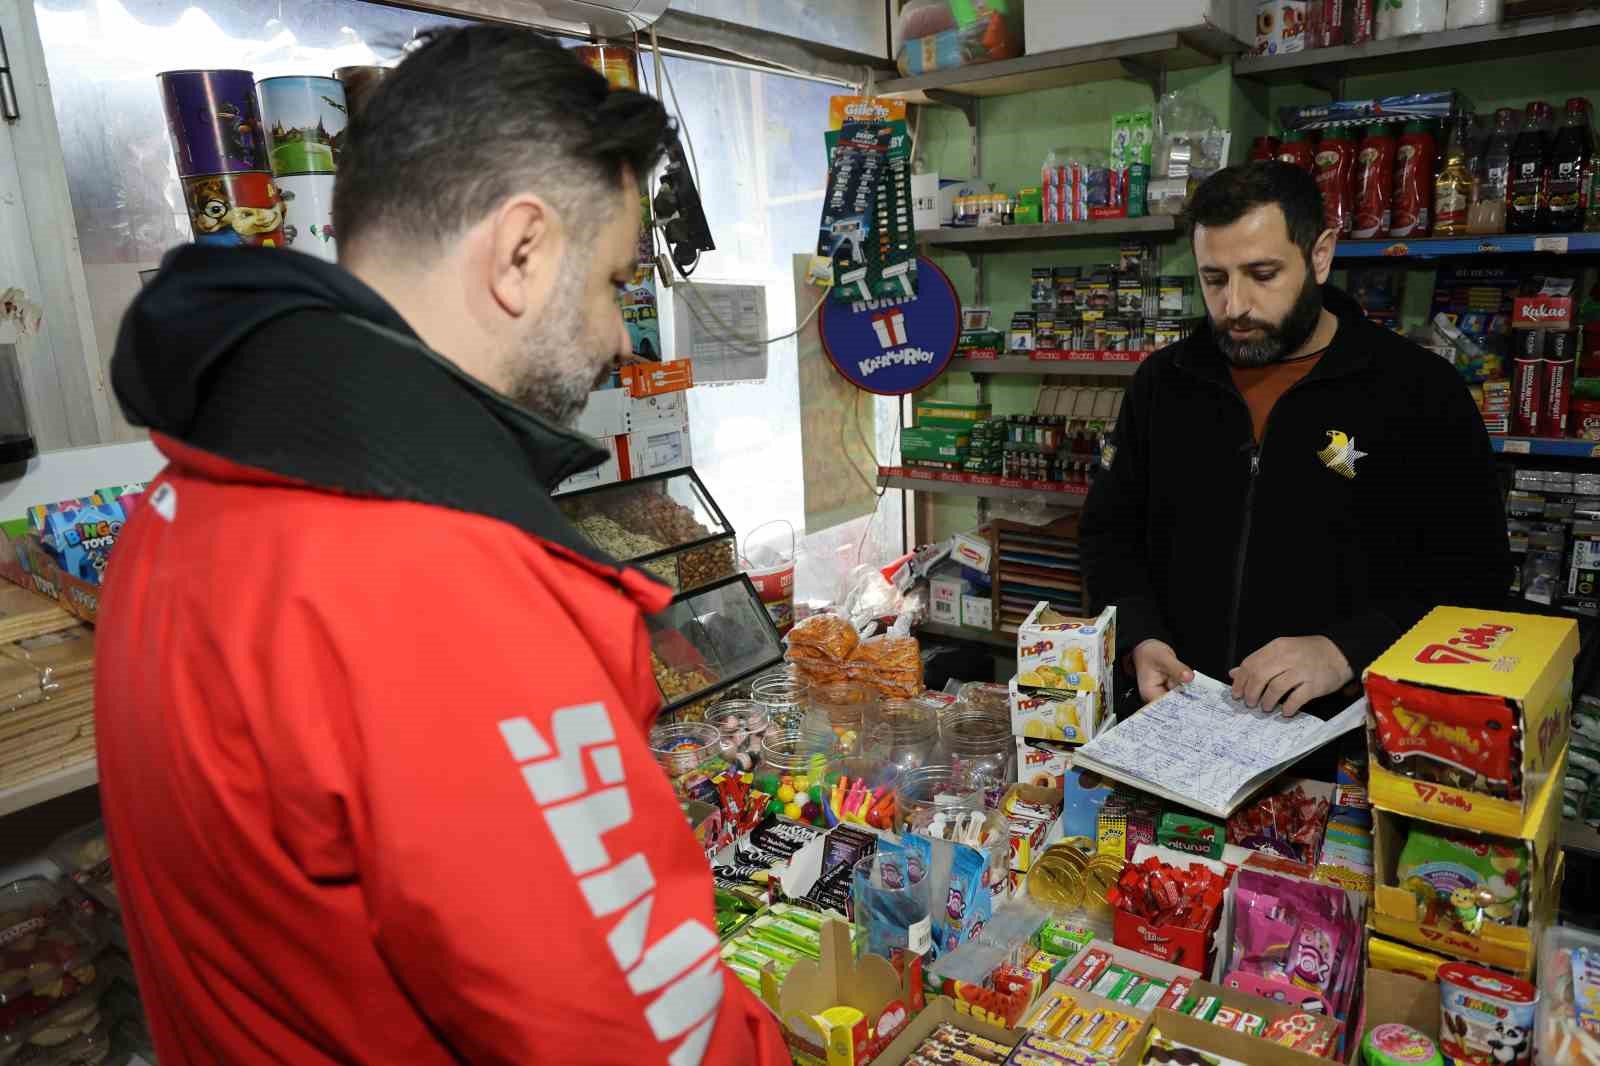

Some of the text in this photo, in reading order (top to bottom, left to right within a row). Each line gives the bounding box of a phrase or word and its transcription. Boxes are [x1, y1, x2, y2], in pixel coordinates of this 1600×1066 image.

[1521, 303, 1568, 321] Kakao
[82, 536, 114, 551] TOYS
[1429, 720, 1480, 753] Jelly
[1438, 791, 1473, 812] Jelly
